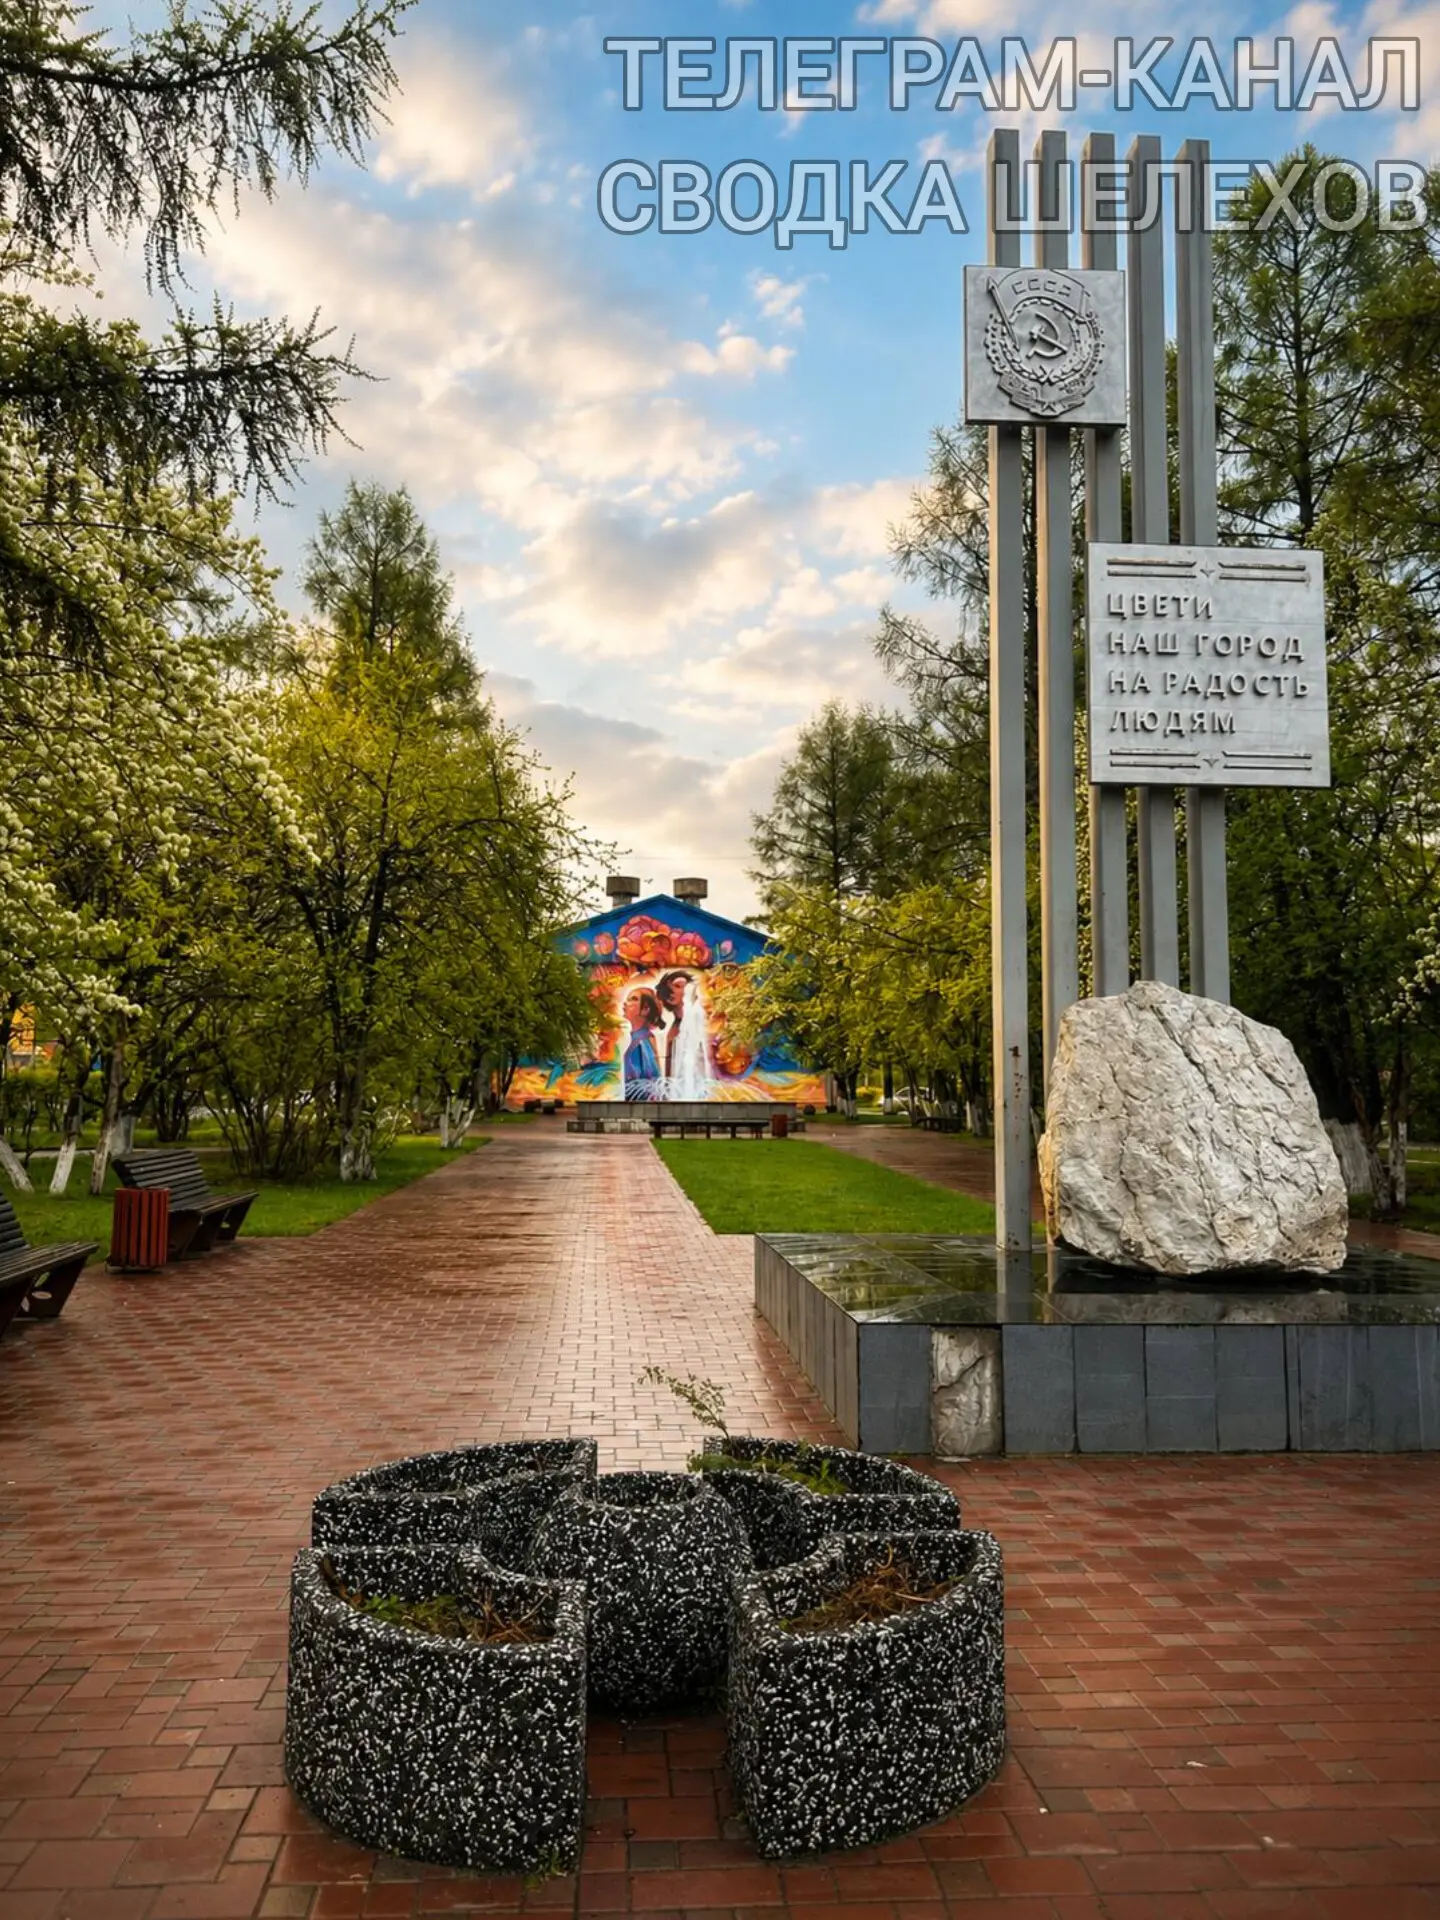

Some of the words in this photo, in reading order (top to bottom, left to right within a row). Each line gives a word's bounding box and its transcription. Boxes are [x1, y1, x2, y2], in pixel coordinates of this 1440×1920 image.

[1107, 593, 1213, 620] ЦВЕТИ
[1108, 631, 1180, 656] НАШ
[1195, 633, 1304, 663] ГОРОД
[1109, 670, 1150, 694] НА
[1163, 671, 1309, 700] РАДОСТЬ
[1109, 710, 1236, 738] ЛЮДЯМ
